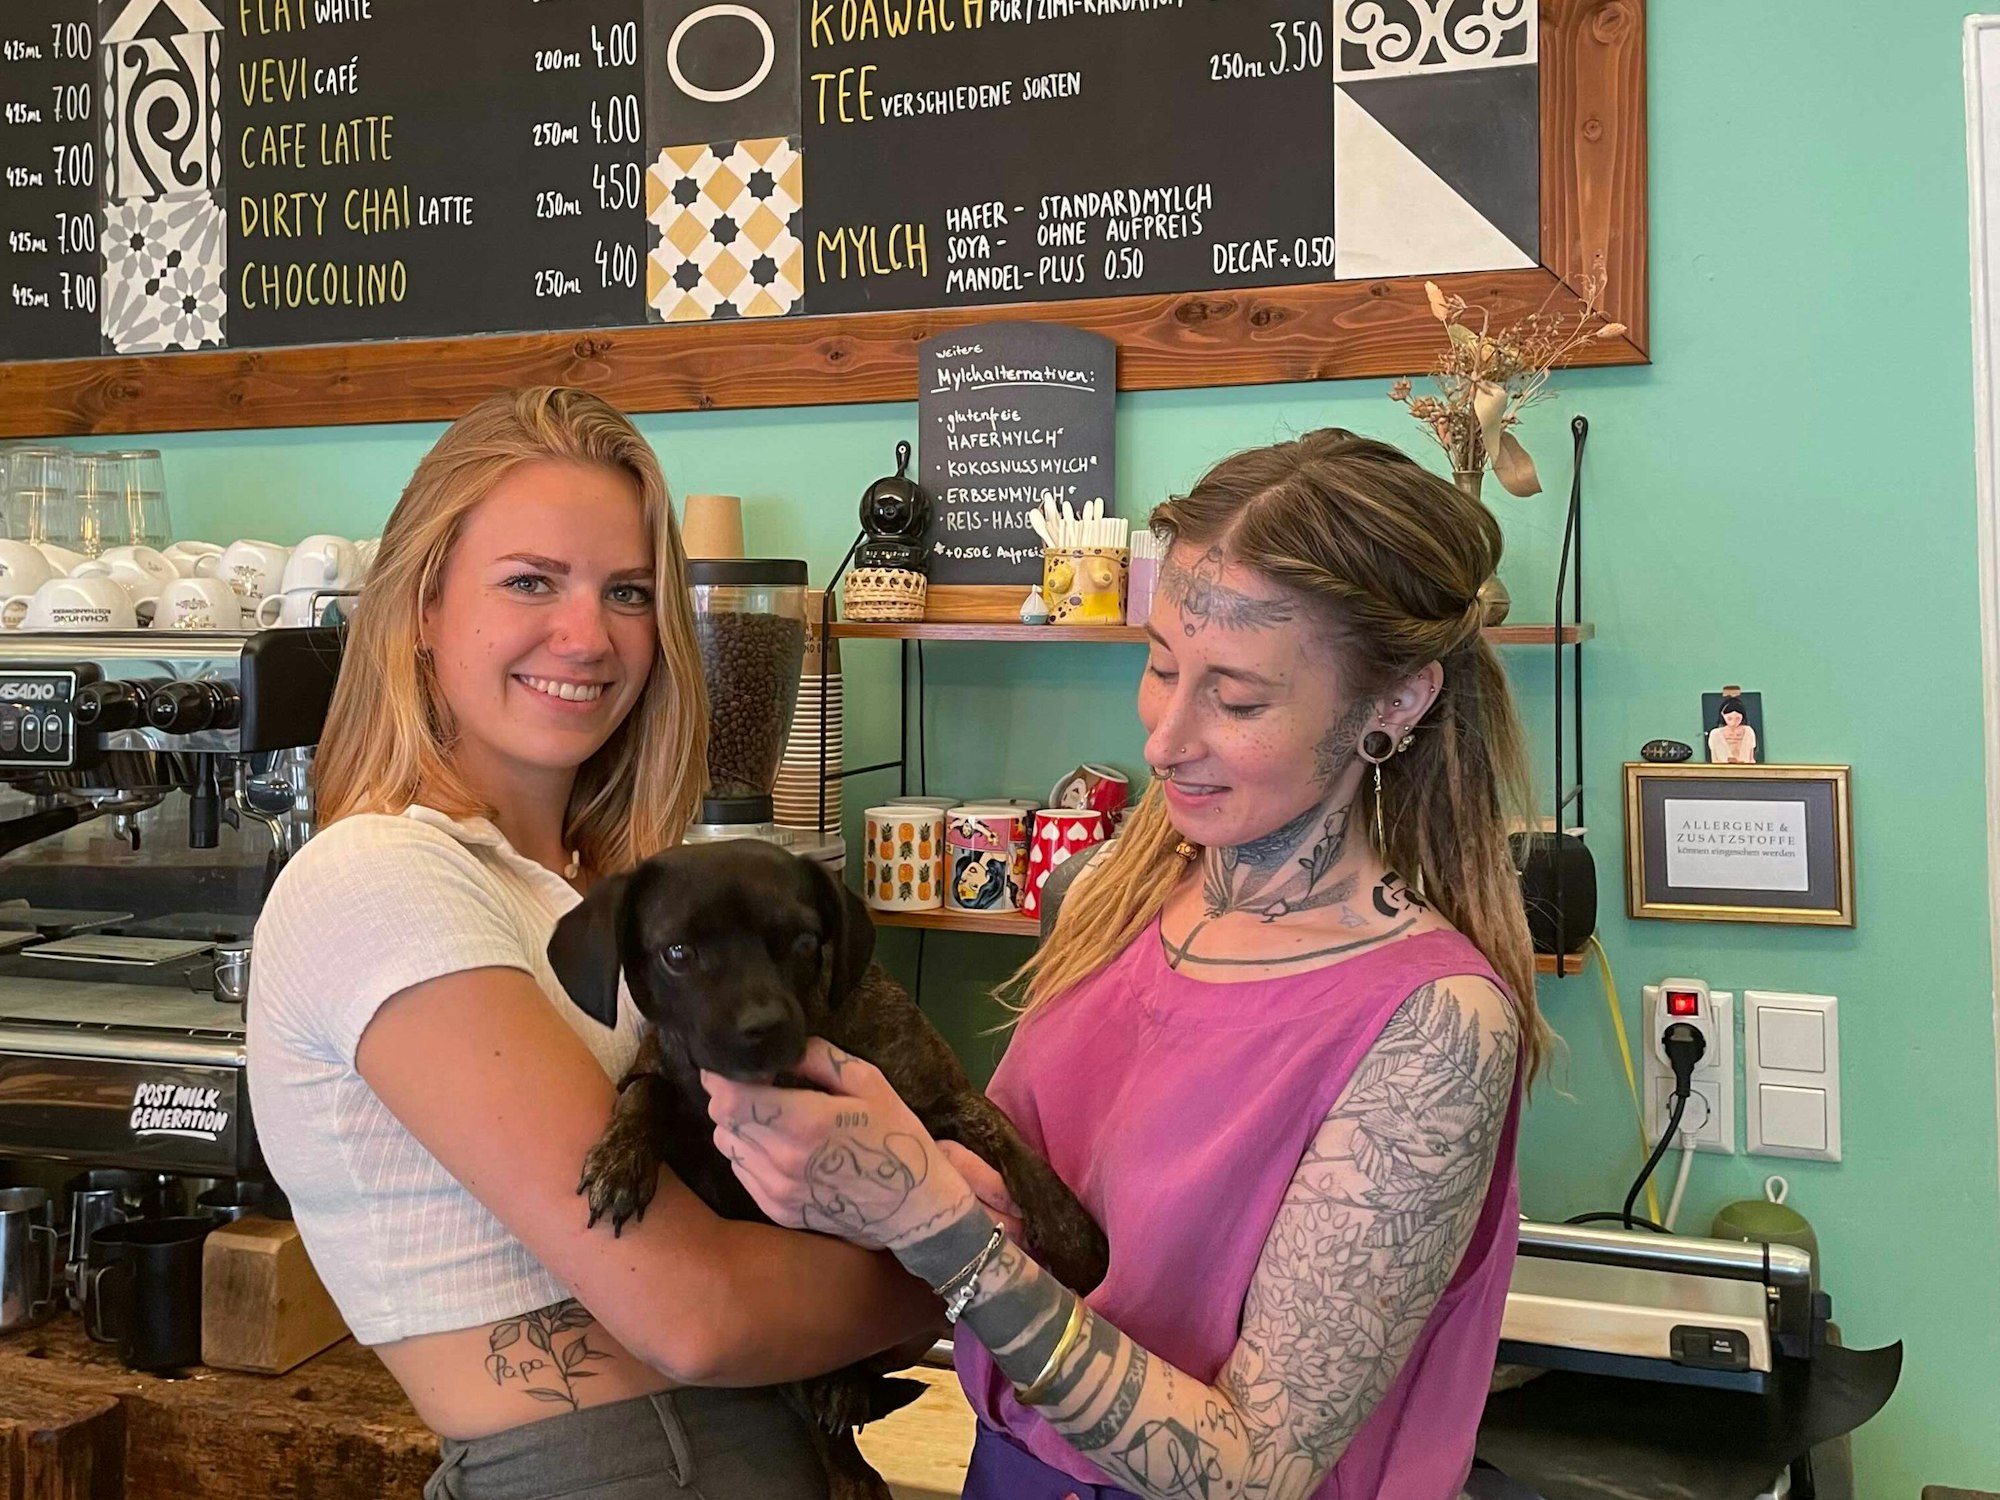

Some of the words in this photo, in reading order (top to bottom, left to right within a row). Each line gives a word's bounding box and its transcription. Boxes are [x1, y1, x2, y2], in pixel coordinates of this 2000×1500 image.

[52, 22, 92, 60] 7.00
[591, 21, 637, 68] 4.00
[811, 0, 984, 48] KOAWACH
[1270, 20, 1323, 75] 3.50
[52, 83, 91, 122] 7.00
[239, 57, 308, 107] VEVI
[314, 55, 359, 96] CAFÉ
[810, 65, 878, 125] TEE
[880, 81, 1013, 117] VERSCHIEDENE
[1022, 71, 1081, 101] SORTEN
[241, 122, 307, 169] CAFE
[321, 115, 394, 166] LATTE
[591, 94, 641, 144] 4.00
[52, 142, 94, 187] 7.00
[592, 162, 641, 210] 4.50
[240, 191, 328, 238] DIRTY
[344, 184, 411, 236] CHAI
[418, 195, 474, 226] LATTE
[946, 201, 1008, 233] HAFER
[1038, 183, 1213, 221] STANDARDMYLCH
[55, 213, 95, 255] 7.00
[816, 223, 928, 283] MYLCH
[946, 234, 990, 264] SOYA
[1036, 220, 1087, 247] OHNE
[1105, 211, 1203, 243] AUFPREIS
[241, 260, 407, 311] CHOCOLINO
[594, 240, 638, 288] 4.00
[1039, 254, 1085, 285] PLUS
[1104, 247, 1145, 281] 0.50
[59, 271, 96, 314] 7.00
[936, 344, 984, 359] weitere
[1677, 833, 1796, 845] ZUSATZSTOFFE
[1683, 820, 1774, 832] ALLERGENE
[1779, 823, 1788, 832] &
[130, 1106, 229, 1132] GENERATION
[133, 1083, 176, 1107] POST
[172, 1086, 220, 1109] MILK
